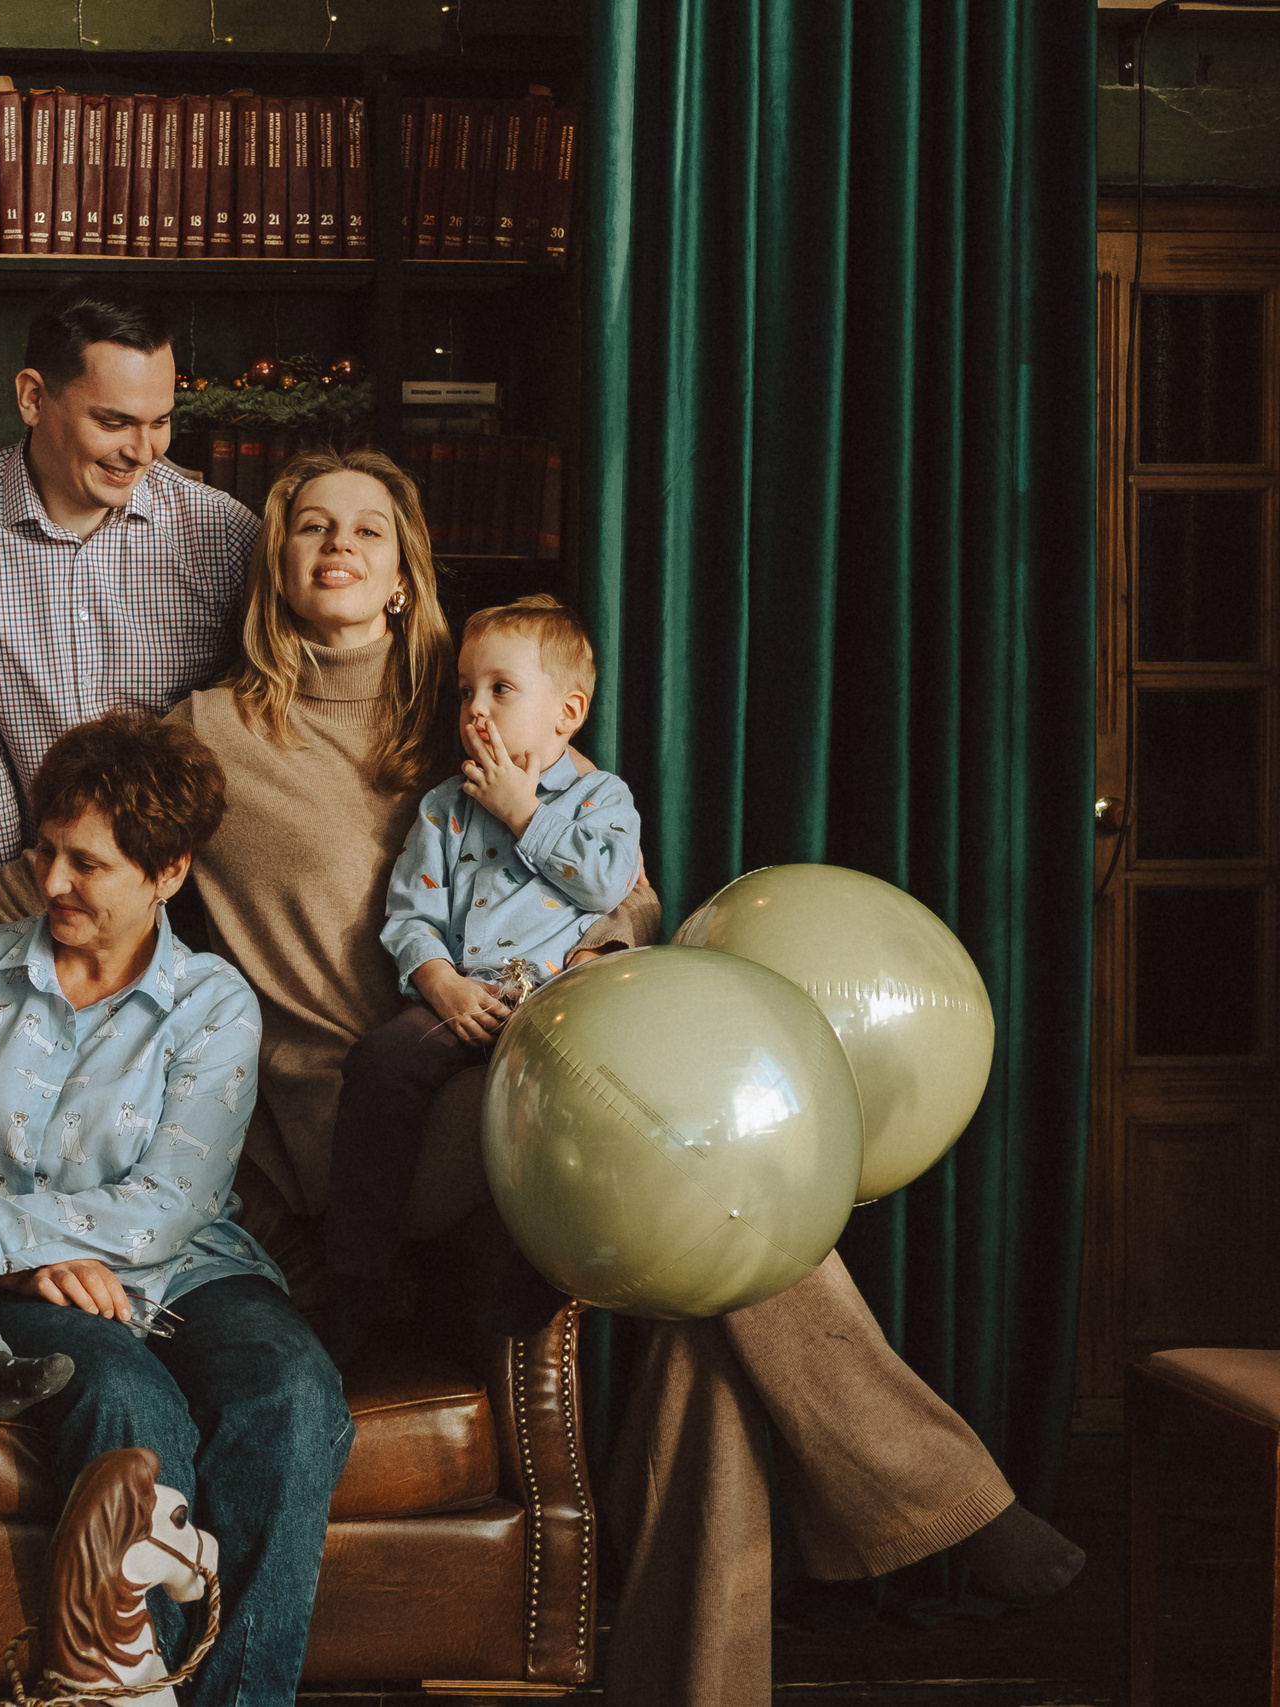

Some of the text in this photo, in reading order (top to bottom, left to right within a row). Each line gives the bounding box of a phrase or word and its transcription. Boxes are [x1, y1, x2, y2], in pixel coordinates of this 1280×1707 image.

[7, 209, 17, 219] 11
[35, 212, 45, 223] 12
[61, 211, 72, 222] 13
[88, 212, 97, 222] 14
[113, 214, 123, 224] 15
[217, 212, 228, 223] 19
[243, 213, 256, 224] 20
[269, 214, 280, 225] 21
[297, 214, 310, 224] 22
[423, 214, 435, 225] 25
[139, 216, 149, 226] 16
[164, 217, 174, 227] 17
[191, 216, 201, 226] 18
[321, 215, 333, 225] 23
[350, 215, 361, 226] 24
[450, 216, 462, 227] 26
[501, 217, 513, 228] 28
[551, 227, 564, 238] 30
